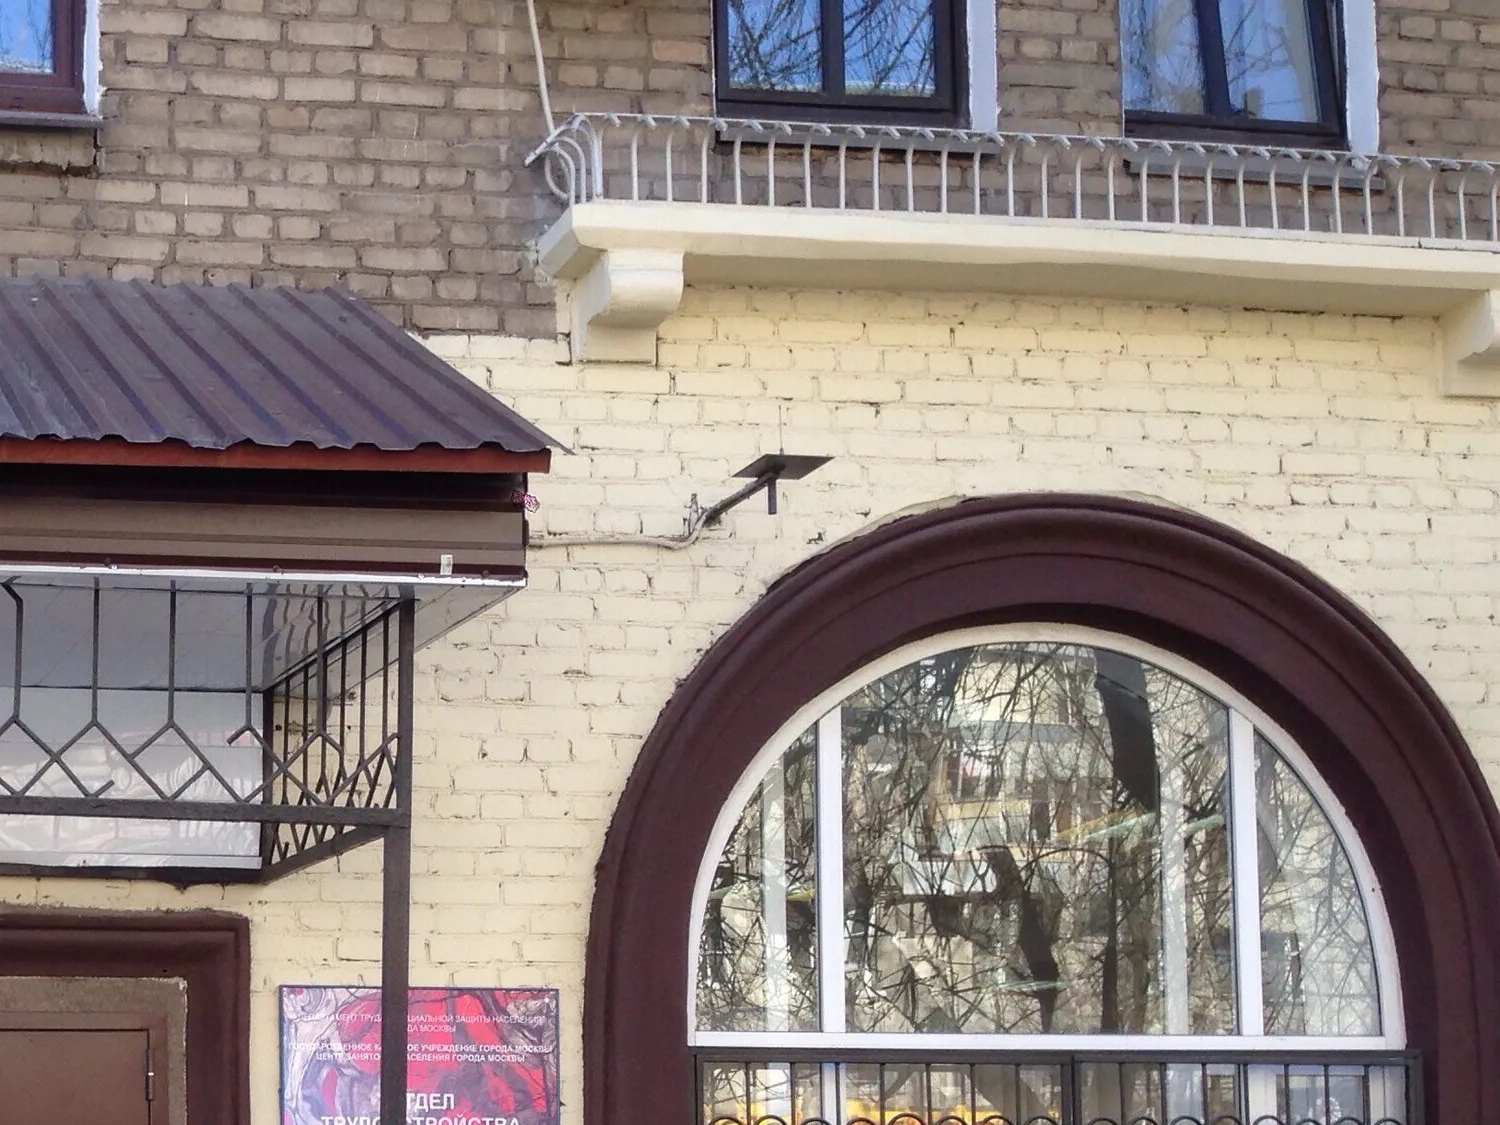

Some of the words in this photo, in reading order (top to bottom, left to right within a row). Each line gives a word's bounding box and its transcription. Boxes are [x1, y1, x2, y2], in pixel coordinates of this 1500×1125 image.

[420, 1024, 456, 1033] МОСКВЫ
[421, 1043, 478, 1053] УЧРЕЖДЕНИЕ
[479, 1044, 513, 1053] ГОРОДА
[514, 1045, 553, 1053] МОСКВЫ
[452, 1053, 485, 1063] ГОРОДА
[487, 1053, 525, 1062] МОСКВЫ
[407, 1092, 454, 1113] ТДЕЛ
